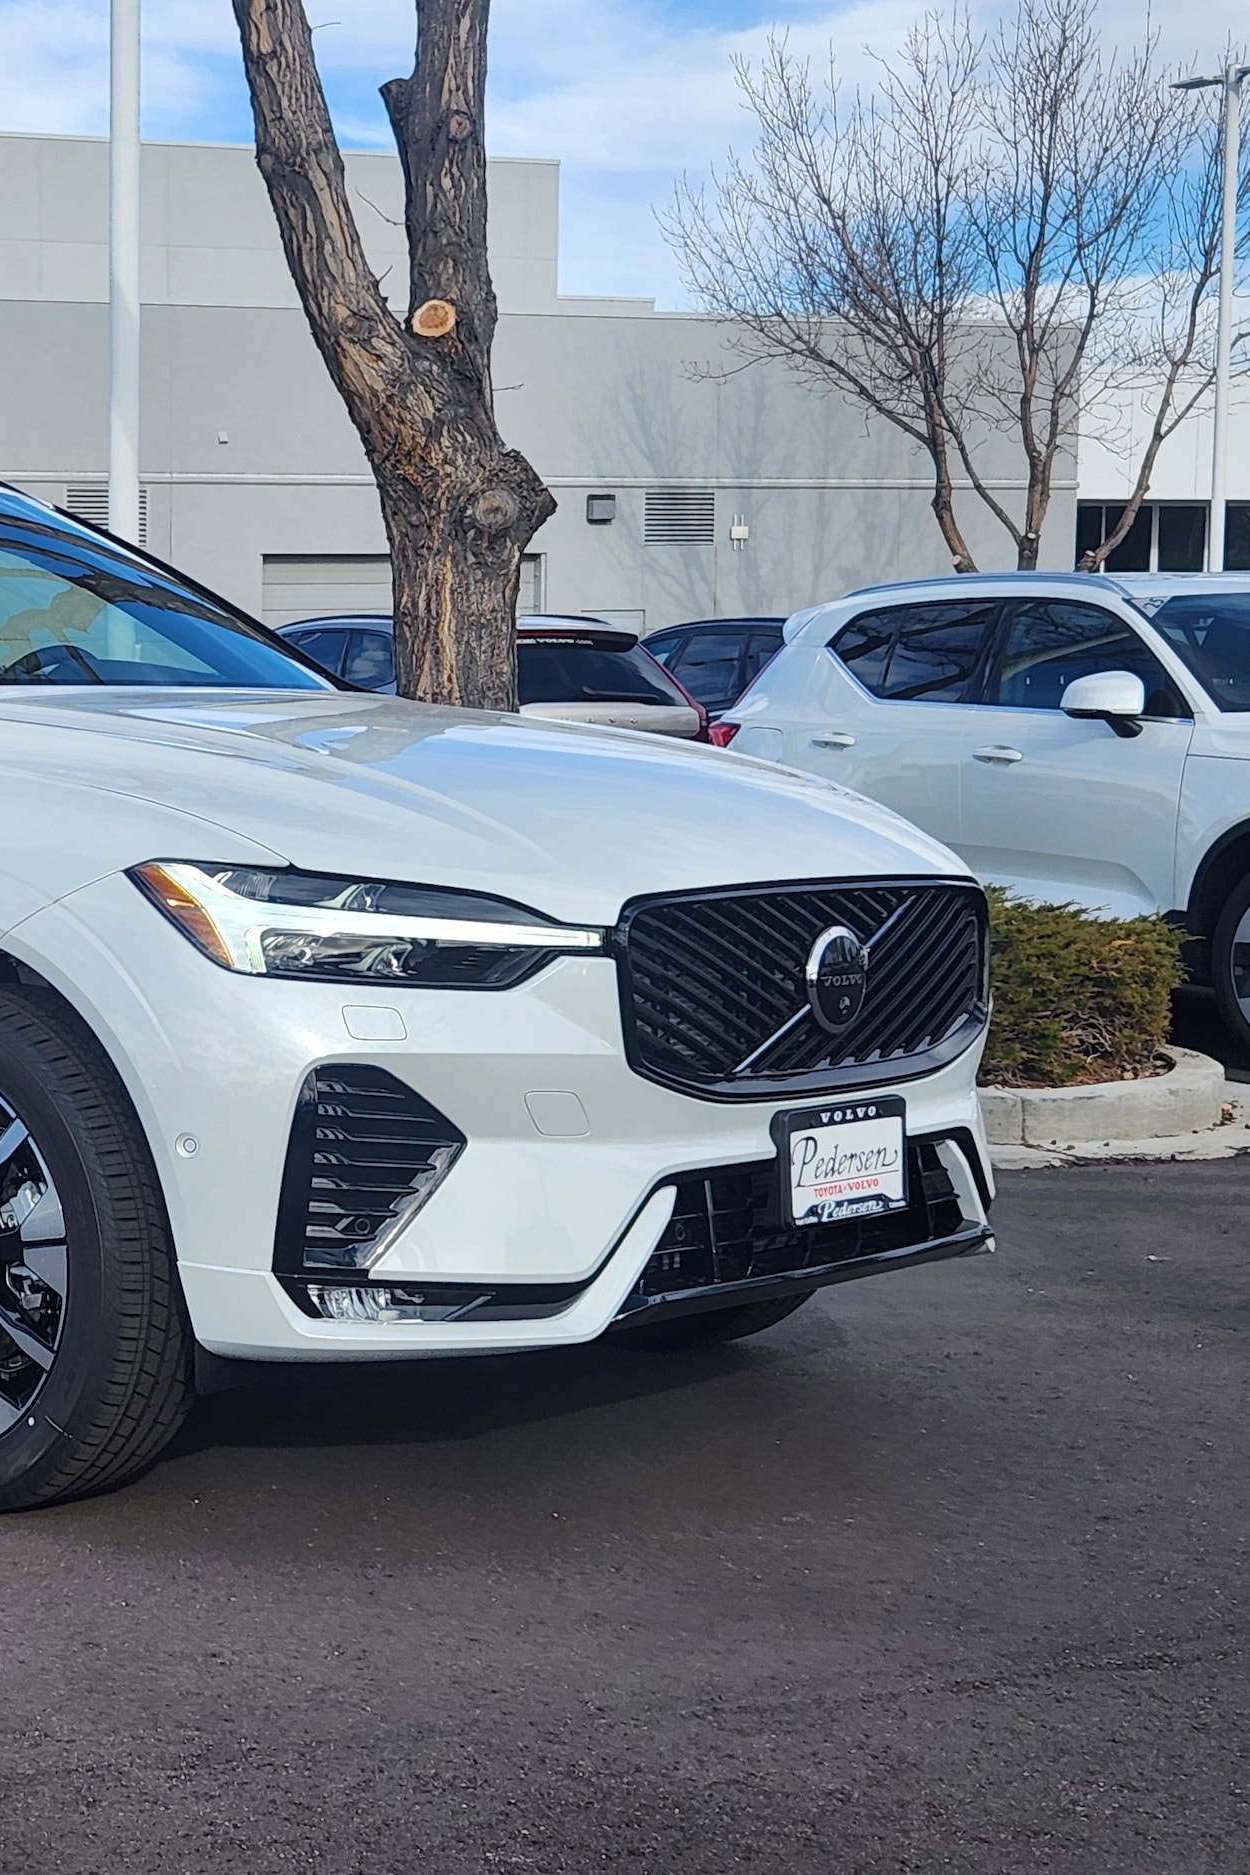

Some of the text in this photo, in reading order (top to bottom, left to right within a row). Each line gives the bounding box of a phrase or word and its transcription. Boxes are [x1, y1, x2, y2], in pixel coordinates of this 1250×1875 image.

[820, 1105, 877, 1123] VOLVO
[792, 1136, 898, 1189] Pedersen
[817, 1200, 885, 1222] Pedersen
